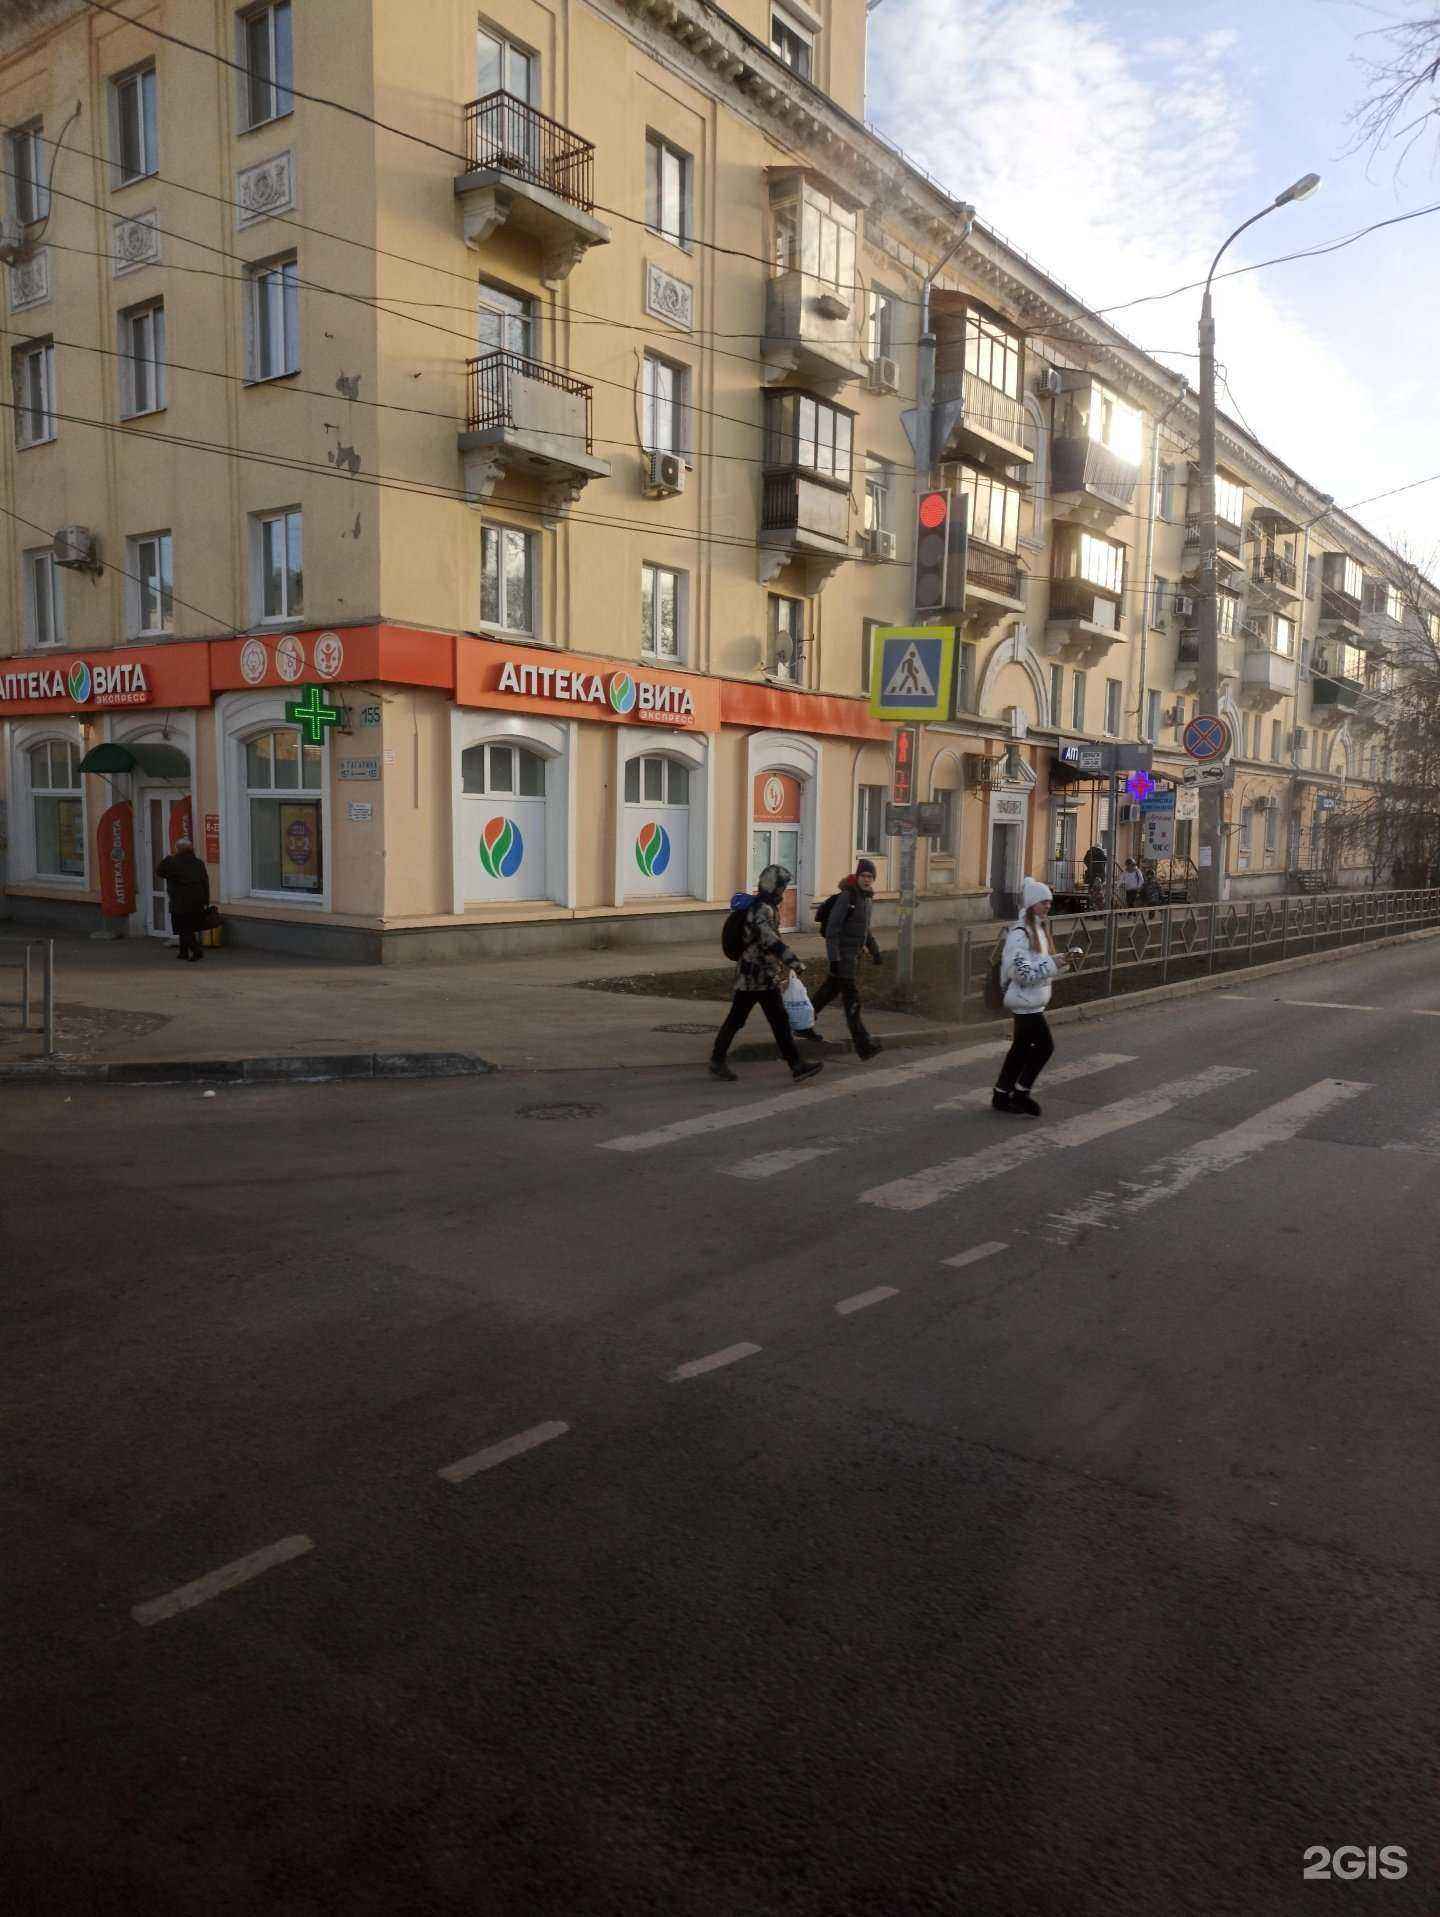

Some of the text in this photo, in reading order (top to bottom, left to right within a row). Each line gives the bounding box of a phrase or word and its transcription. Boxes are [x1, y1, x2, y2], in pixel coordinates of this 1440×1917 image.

[93, 663, 147, 694] ВИТА
[498, 662, 695, 714] АПТЕКА ВИТА
[95, 693, 147, 704] ЭКСПРЕСС
[639, 710, 695, 725] ЭКСПРЕСС
